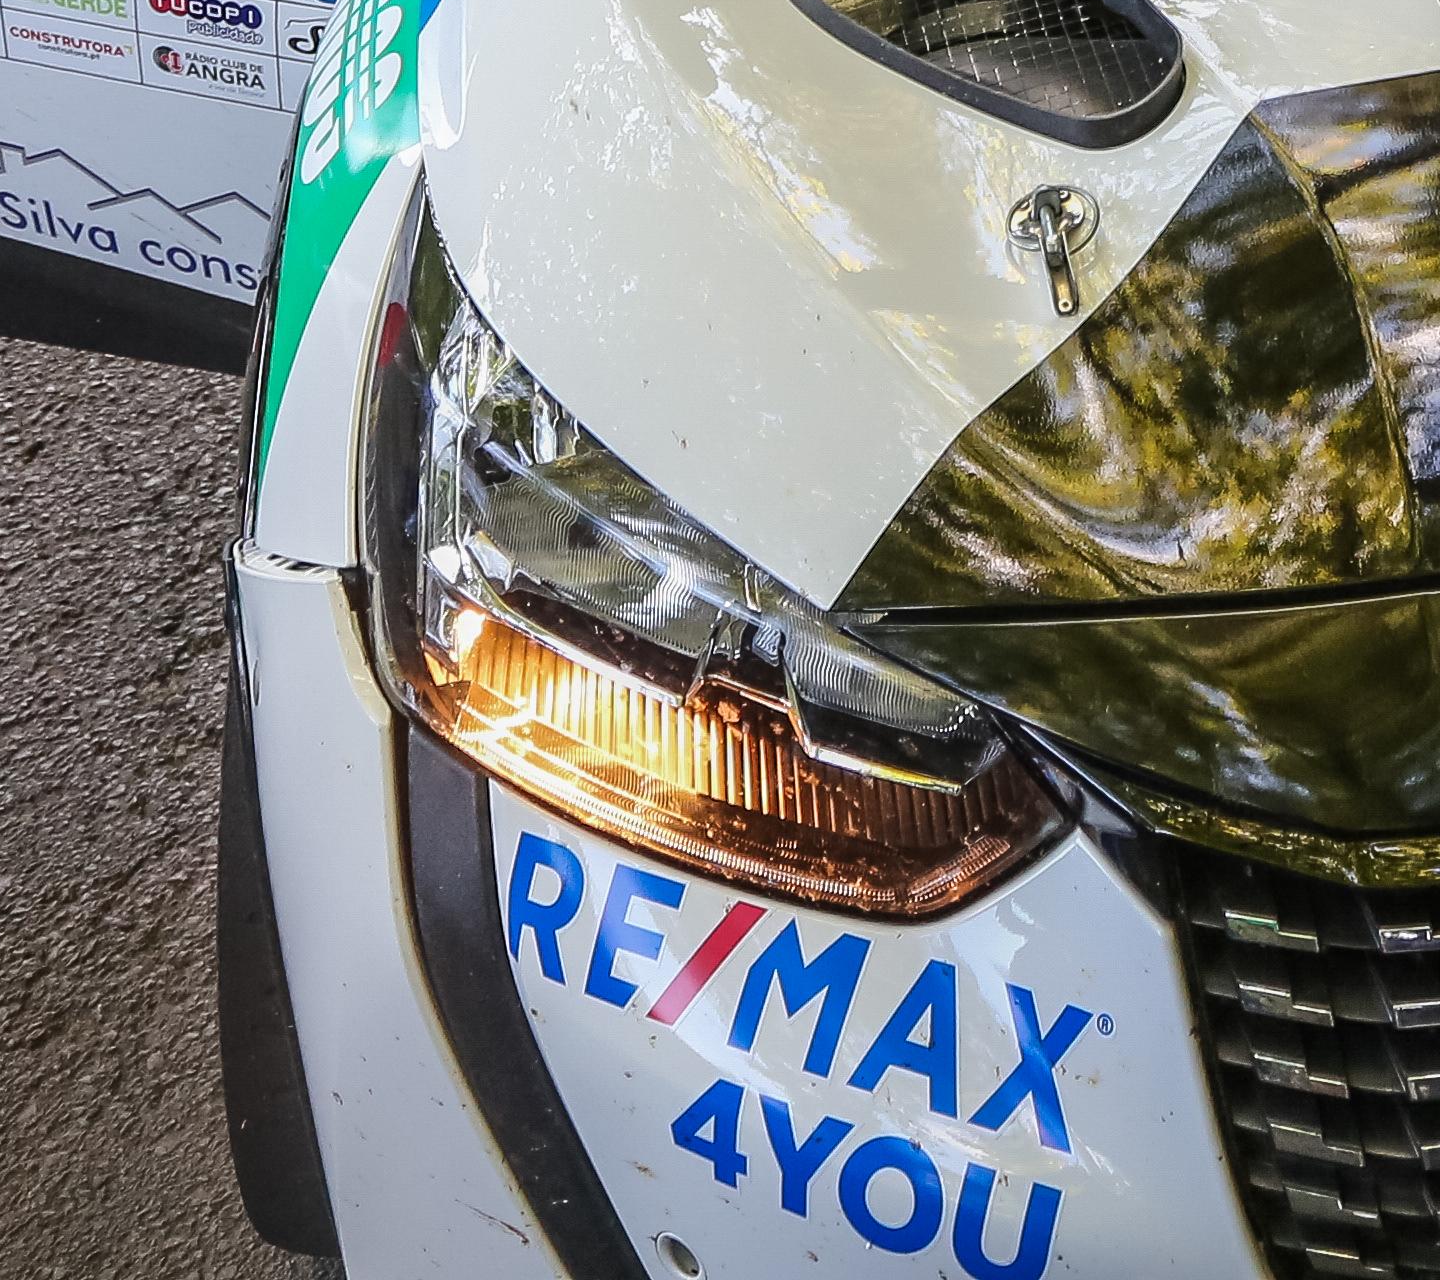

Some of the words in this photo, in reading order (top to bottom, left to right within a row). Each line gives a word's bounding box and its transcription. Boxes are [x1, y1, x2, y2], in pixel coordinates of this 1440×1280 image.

[10, 26, 125, 57] CONSTRUTORA
[185, 52, 218, 65] RÁDIO
[220, 57, 248, 70] CLUB
[249, 64, 264, 74] DE
[186, 62, 266, 90] ANGRA
[139, 238, 260, 292] cons
[672, 1079, 1062, 1280] 4YOU
